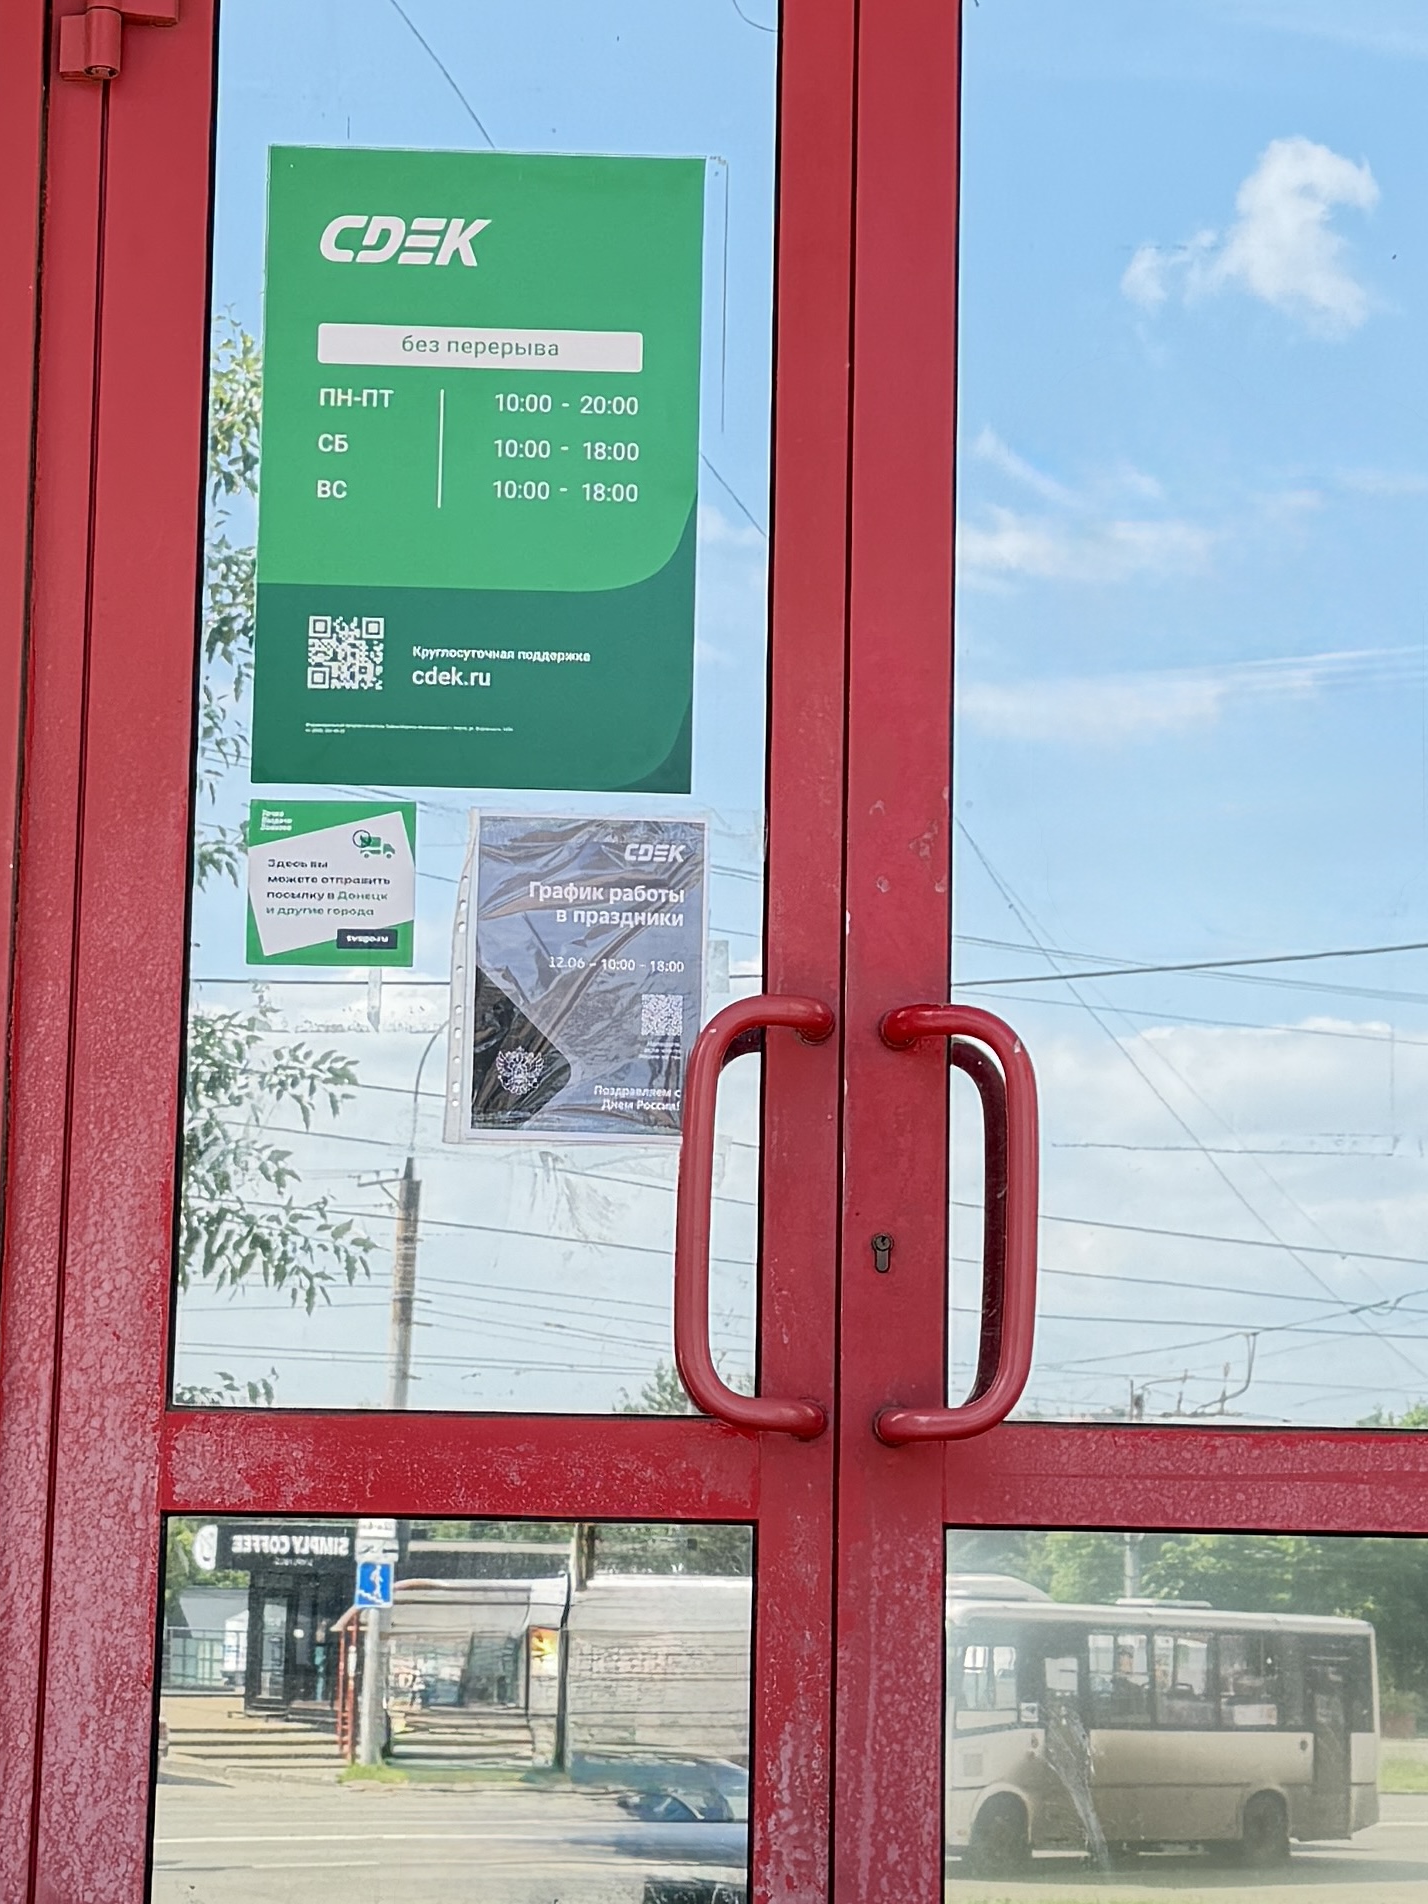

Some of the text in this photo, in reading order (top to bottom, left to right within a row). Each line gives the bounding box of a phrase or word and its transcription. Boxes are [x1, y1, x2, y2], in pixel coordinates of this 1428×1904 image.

[320, 215, 492, 267] CDEK
[401, 335, 559, 358] без перерыва
[319, 387, 395, 408] ПН-ПТ
[495, 393, 552, 413] 10:00
[580, 395, 639, 415] 20:00
[318, 433, 349, 453] СБ
[494, 439, 551, 458] 10:00
[583, 442, 640, 461] 18:00
[317, 479, 348, 498] ВС
[493, 480, 550, 500] 10:00
[582, 483, 639, 503] 18:00
[412, 646, 591, 663] Круглосуточная поддержка
[412, 666, 491, 687] cdek.ru
[624, 843, 686, 863] CDEK
[337, 891, 388, 902] Донецк
[529, 881, 685, 904] График работы
[327, 908, 374, 916] города
[556, 909, 684, 928] в праздники
[548, 956, 586, 968] 12.06
[601, 958, 636, 971] 10:00
[650, 960, 685, 973] 18:00
